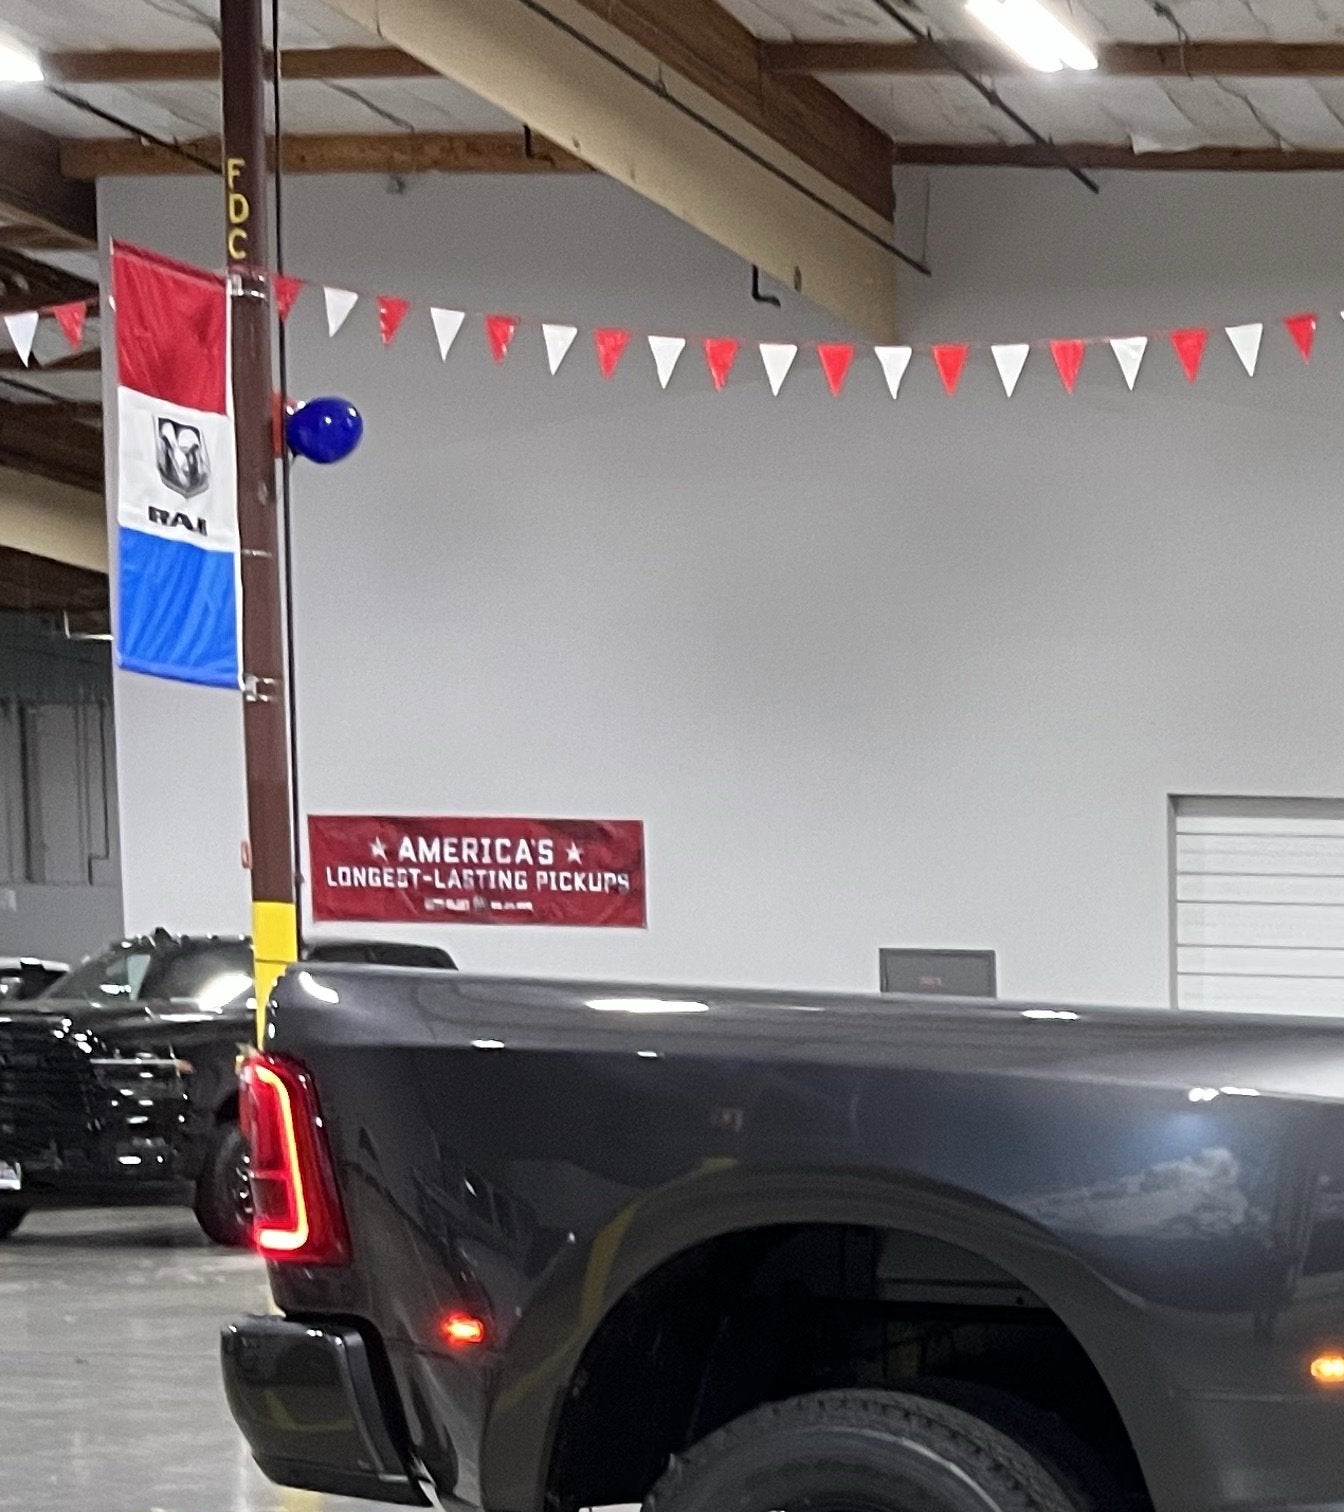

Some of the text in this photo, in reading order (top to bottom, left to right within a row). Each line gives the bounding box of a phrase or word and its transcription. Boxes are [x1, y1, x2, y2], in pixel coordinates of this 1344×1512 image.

[227, 157, 250, 260] FDC
[399, 836, 554, 866] AMERICA'S
[325, 866, 630, 895] LONGEST-LASTING PICKUPS
